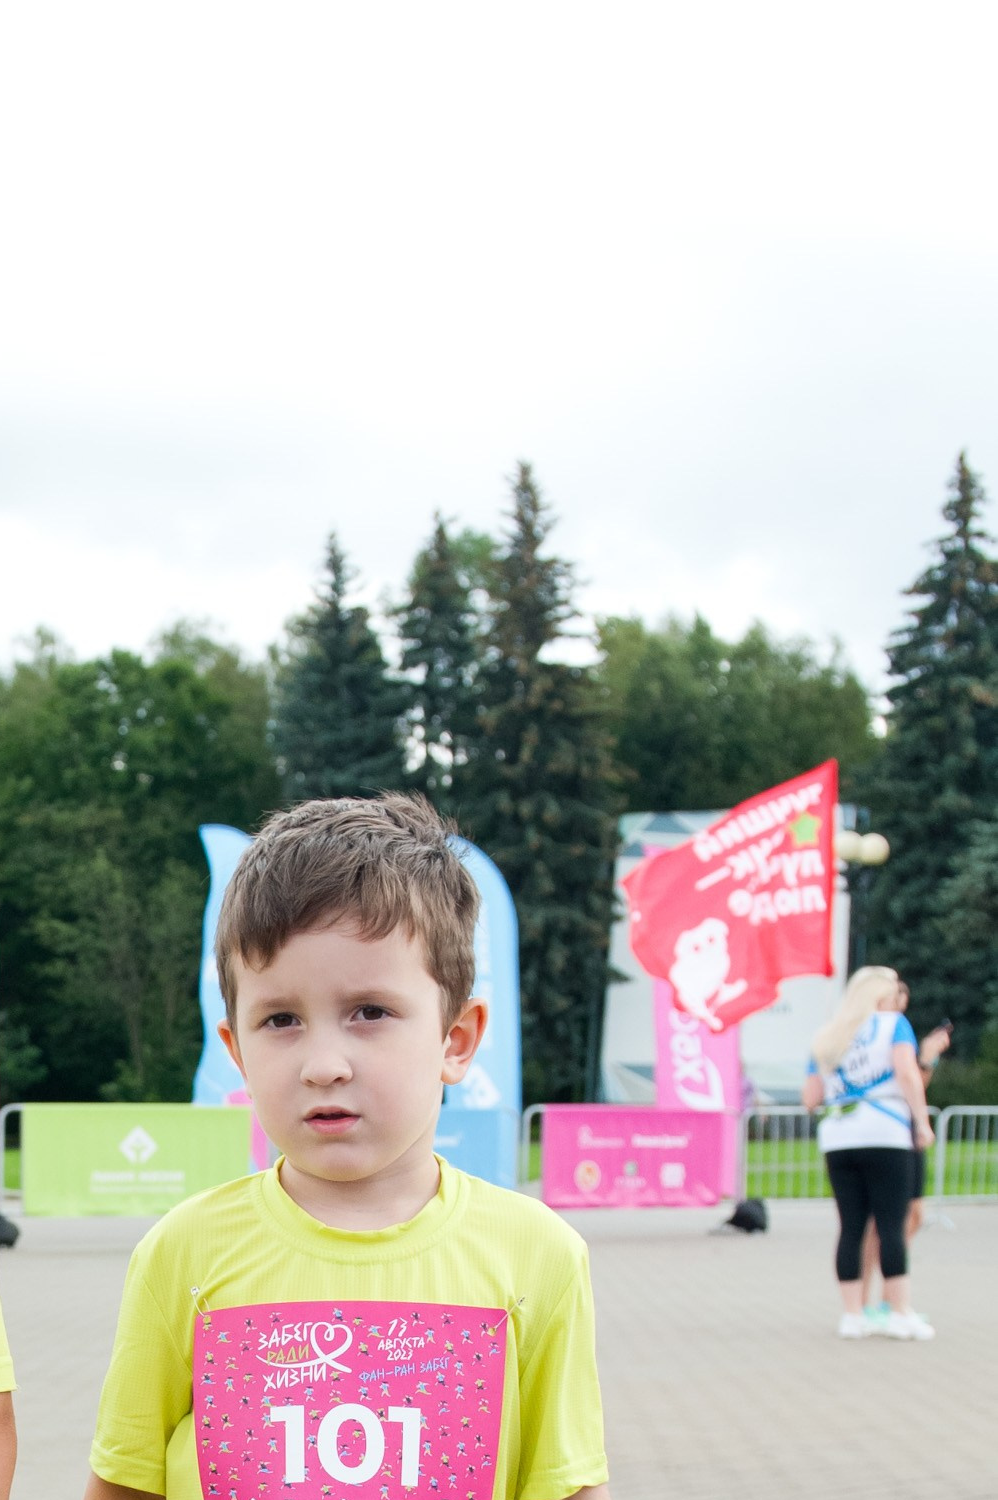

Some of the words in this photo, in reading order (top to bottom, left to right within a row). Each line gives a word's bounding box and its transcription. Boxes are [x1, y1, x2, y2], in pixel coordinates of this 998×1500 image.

[258, 1322, 314, 1350] ЗАБЕГ
[388, 1317, 408, 1337] 13
[266, 1343, 309, 1366] РАДИ
[377, 1337, 425, 1351] АВГУСТА
[386, 1348, 413, 1361] 2023
[420, 1356, 450, 1374] ЗАБЕГ
[262, 1363, 326, 1392] ЖИЗНИ
[270, 1403, 421, 1486] 101
